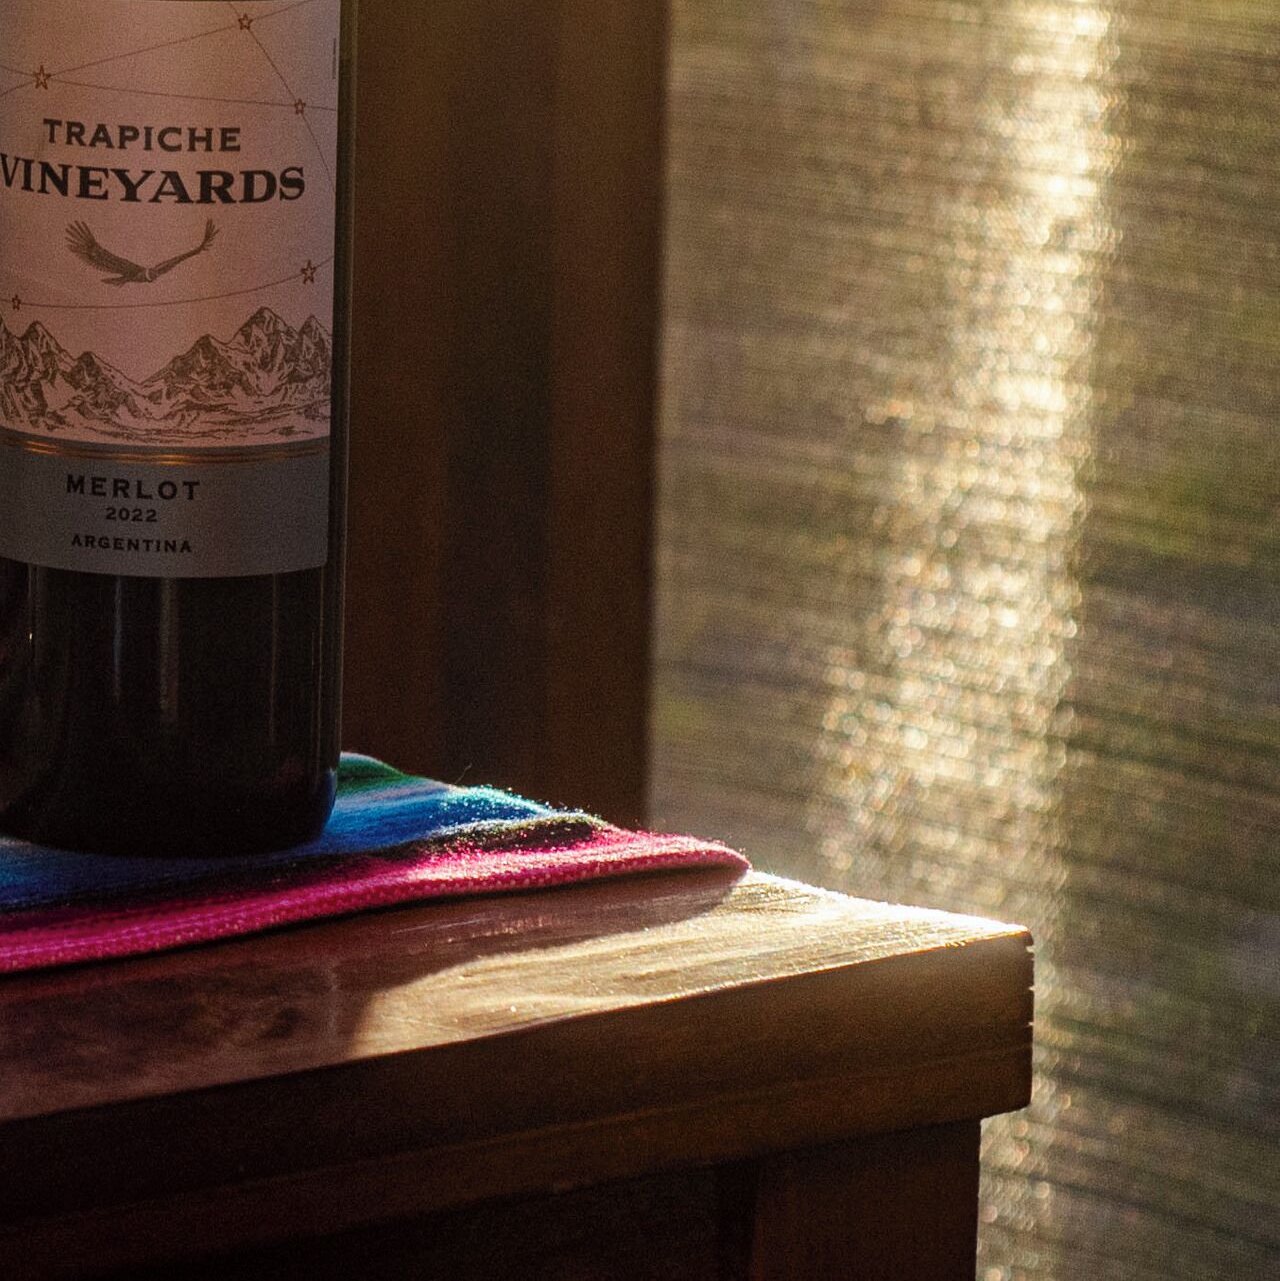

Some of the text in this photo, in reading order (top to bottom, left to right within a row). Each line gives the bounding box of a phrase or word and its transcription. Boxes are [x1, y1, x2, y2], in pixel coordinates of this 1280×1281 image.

[43, 118, 241, 152] TRAPICHE
[0, 153, 306, 204] VINEYARDS
[66, 474, 201, 501] MERLOT
[104, 507, 158, 523] 2022
[71, 534, 193, 553] ARGENTINA
